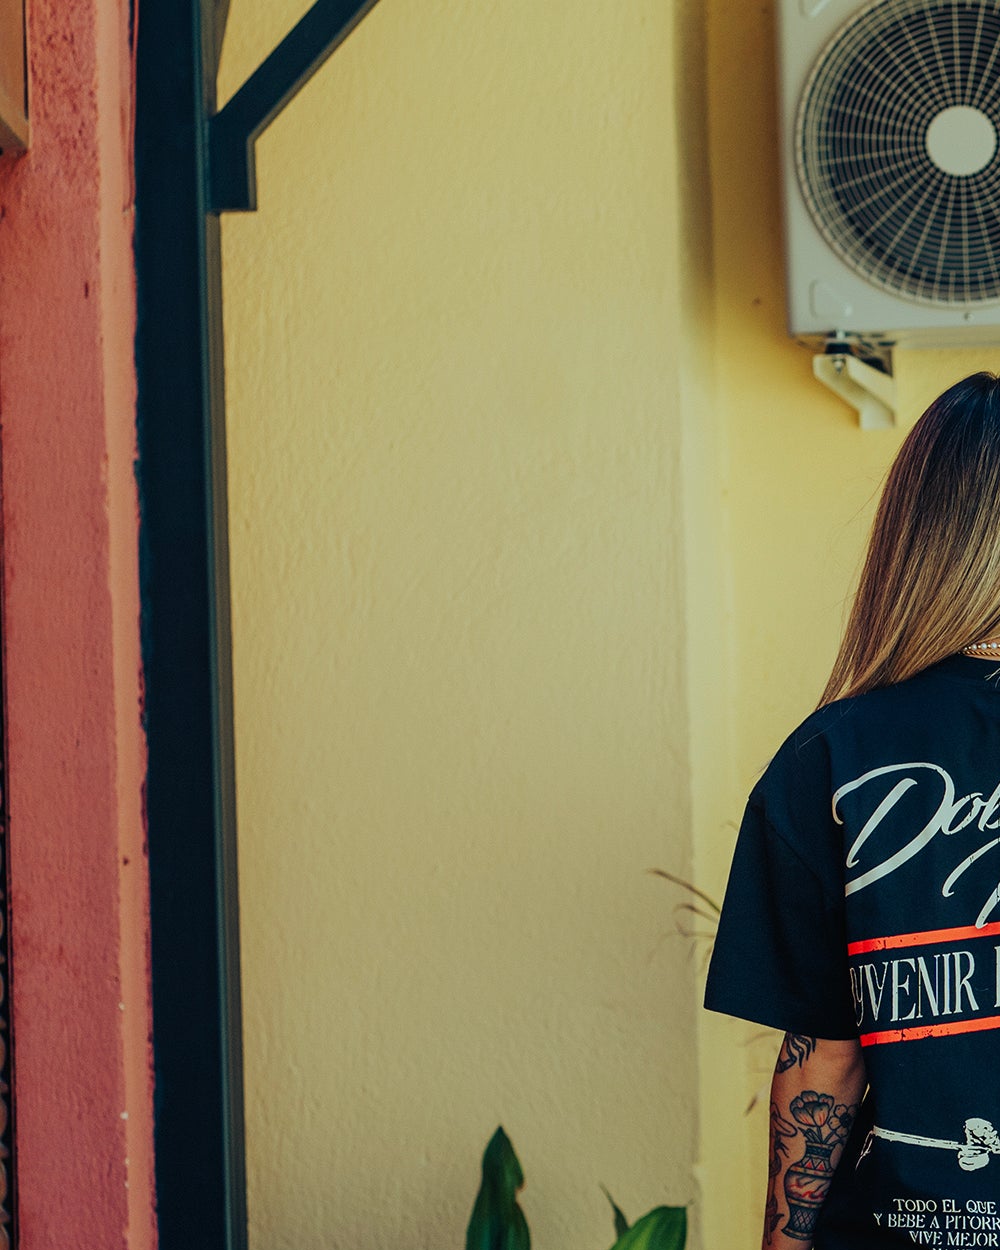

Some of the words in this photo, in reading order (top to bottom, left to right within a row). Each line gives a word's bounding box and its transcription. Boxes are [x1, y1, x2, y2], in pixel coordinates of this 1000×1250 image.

[892, 1198, 938, 1213] TODO
[942, 1198, 962, 1213] EL
[966, 1199, 997, 1216] QUE
[873, 1212, 883, 1226] Y
[887, 1213, 926, 1229] BEBE
[929, 1215, 940, 1229] A
[908, 1230, 943, 1245] VIVE
[947, 1231, 999, 1247] MEJOR
